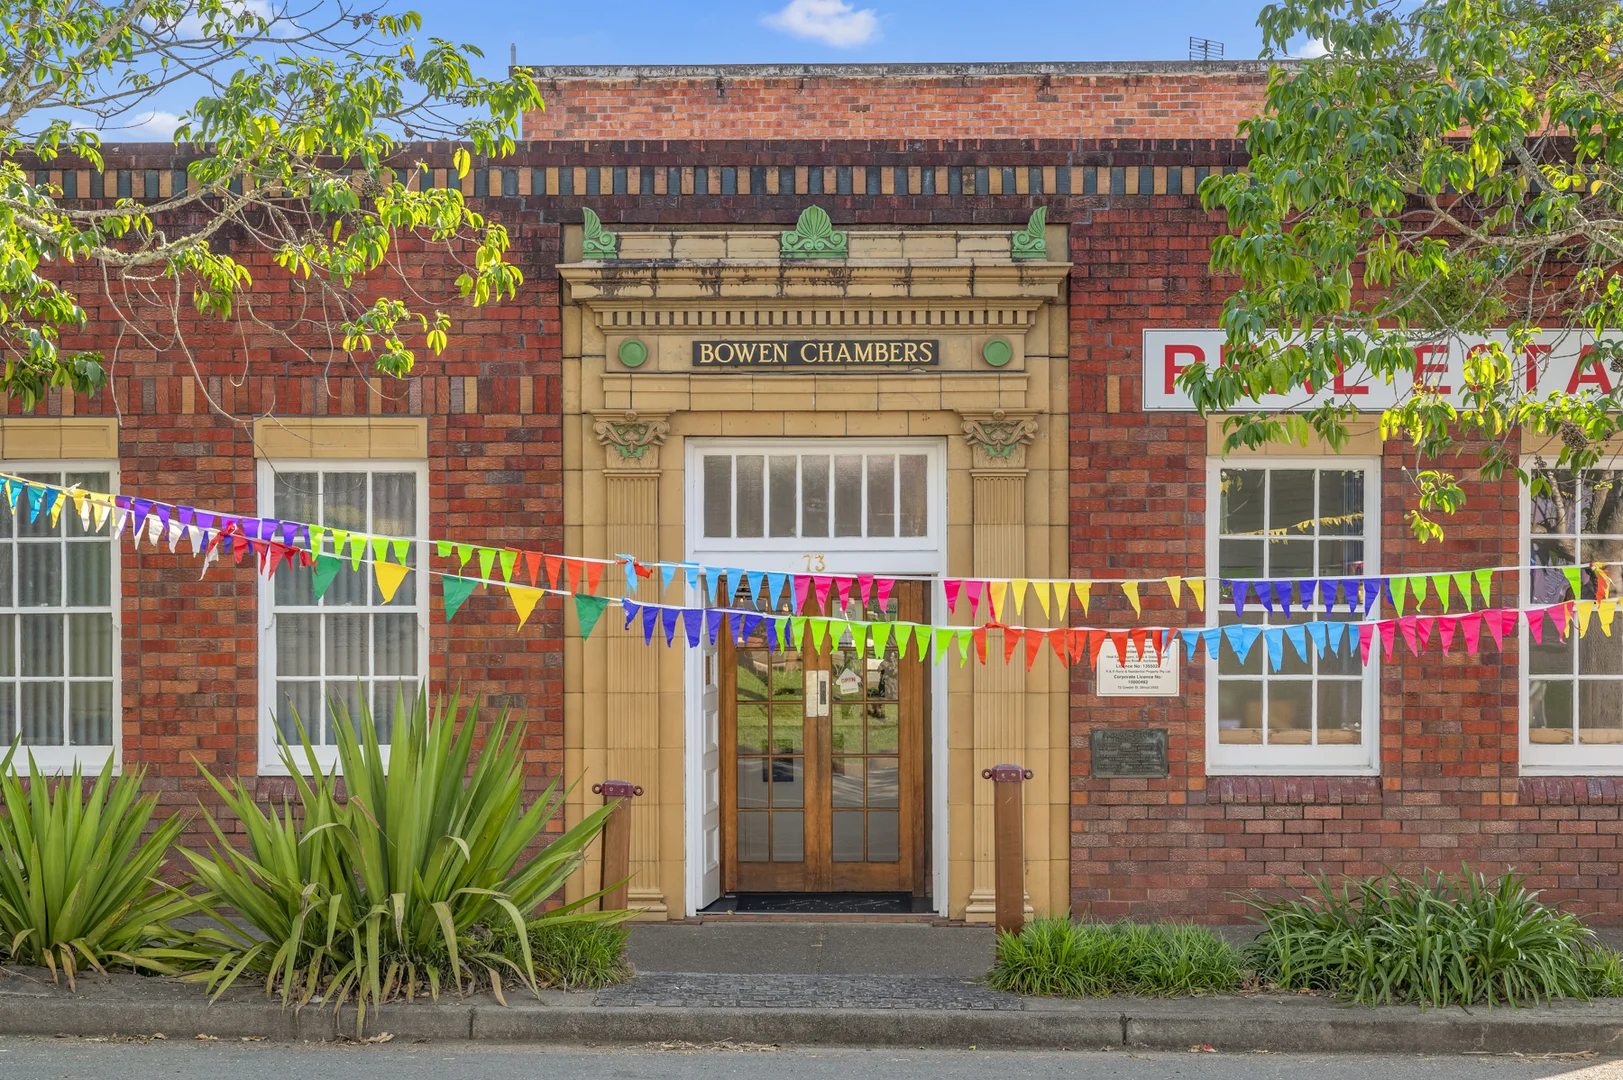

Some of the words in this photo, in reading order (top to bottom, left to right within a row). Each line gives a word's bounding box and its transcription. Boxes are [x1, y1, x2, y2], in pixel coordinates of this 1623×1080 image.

[699, 343, 789, 364] BOWEN
[800, 342, 933, 363] CHAMBERS
[1164, 344, 1369, 395] RL
[803, 554, 826, 573] 73
